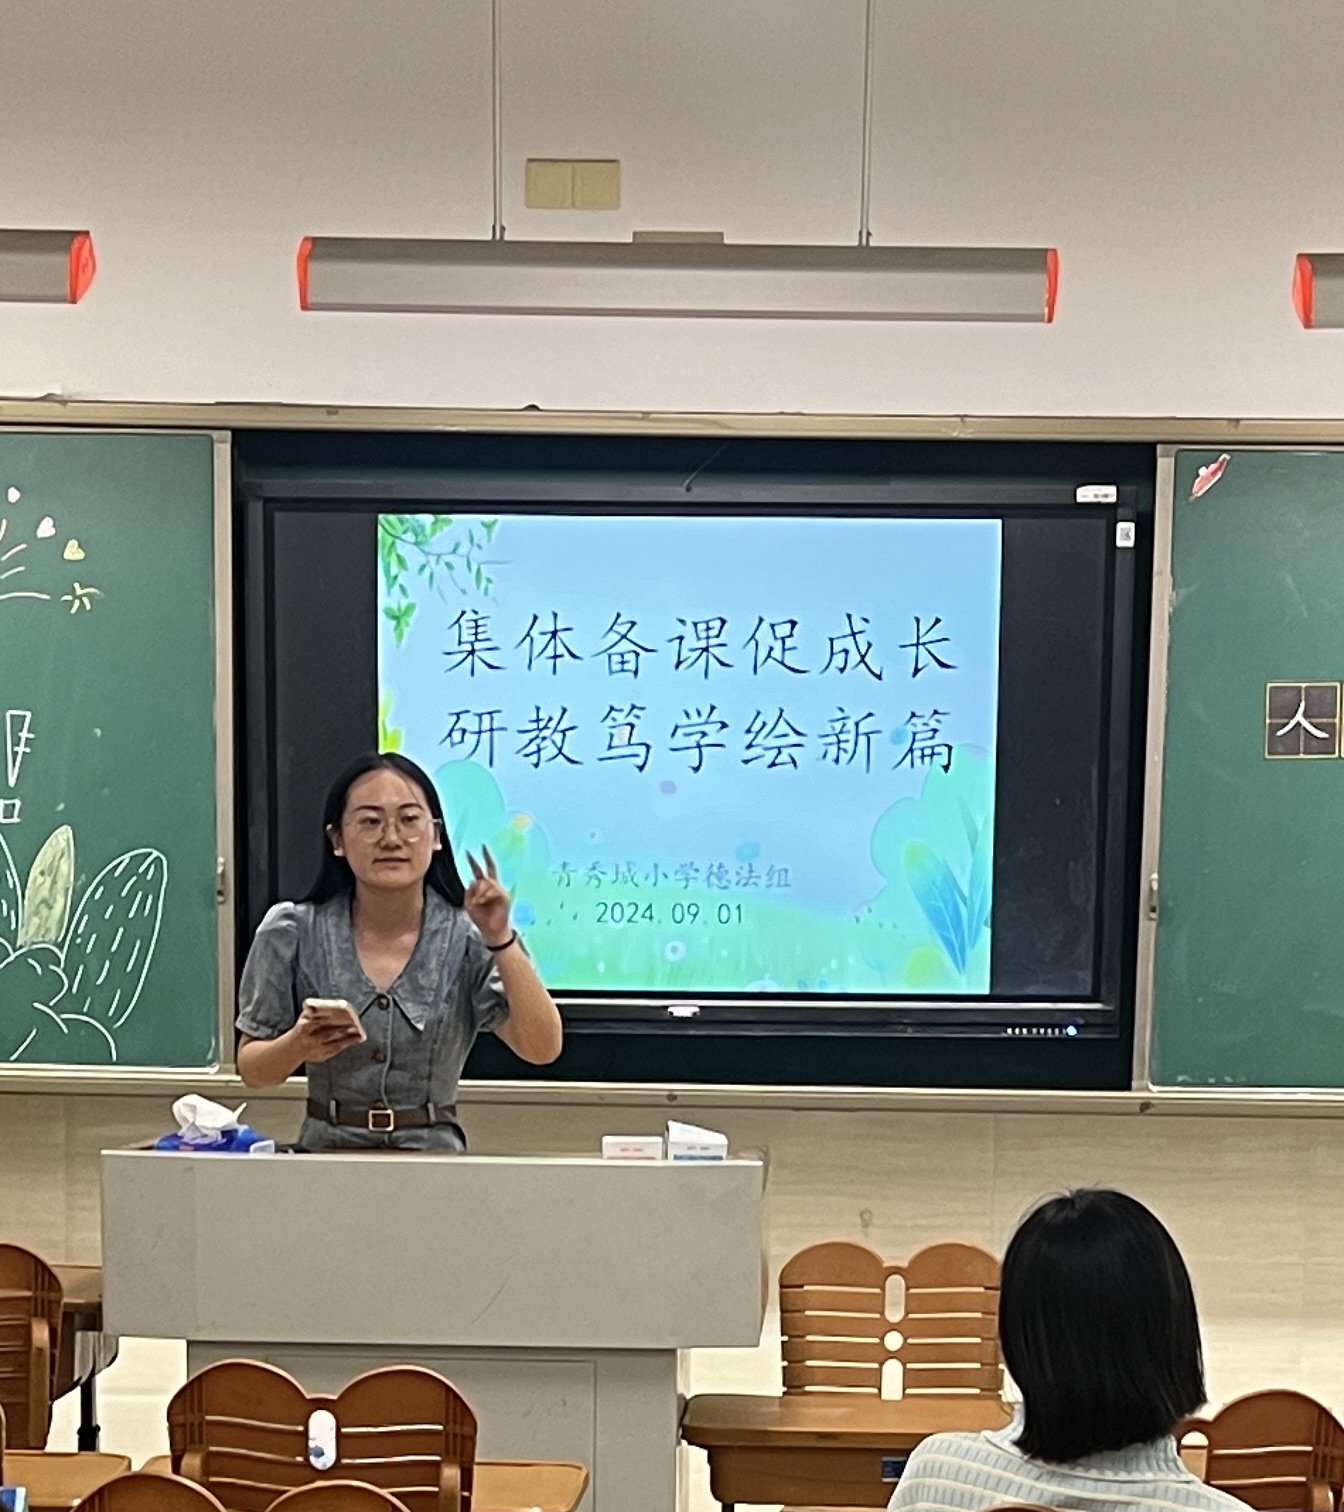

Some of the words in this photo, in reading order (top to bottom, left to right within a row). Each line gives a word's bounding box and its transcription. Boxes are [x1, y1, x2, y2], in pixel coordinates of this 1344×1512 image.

[441, 608, 961, 681] 集体备课促成长
[438, 703, 957, 776] 研教笃学绘新篇
[1275, 701, 1330, 739] 人
